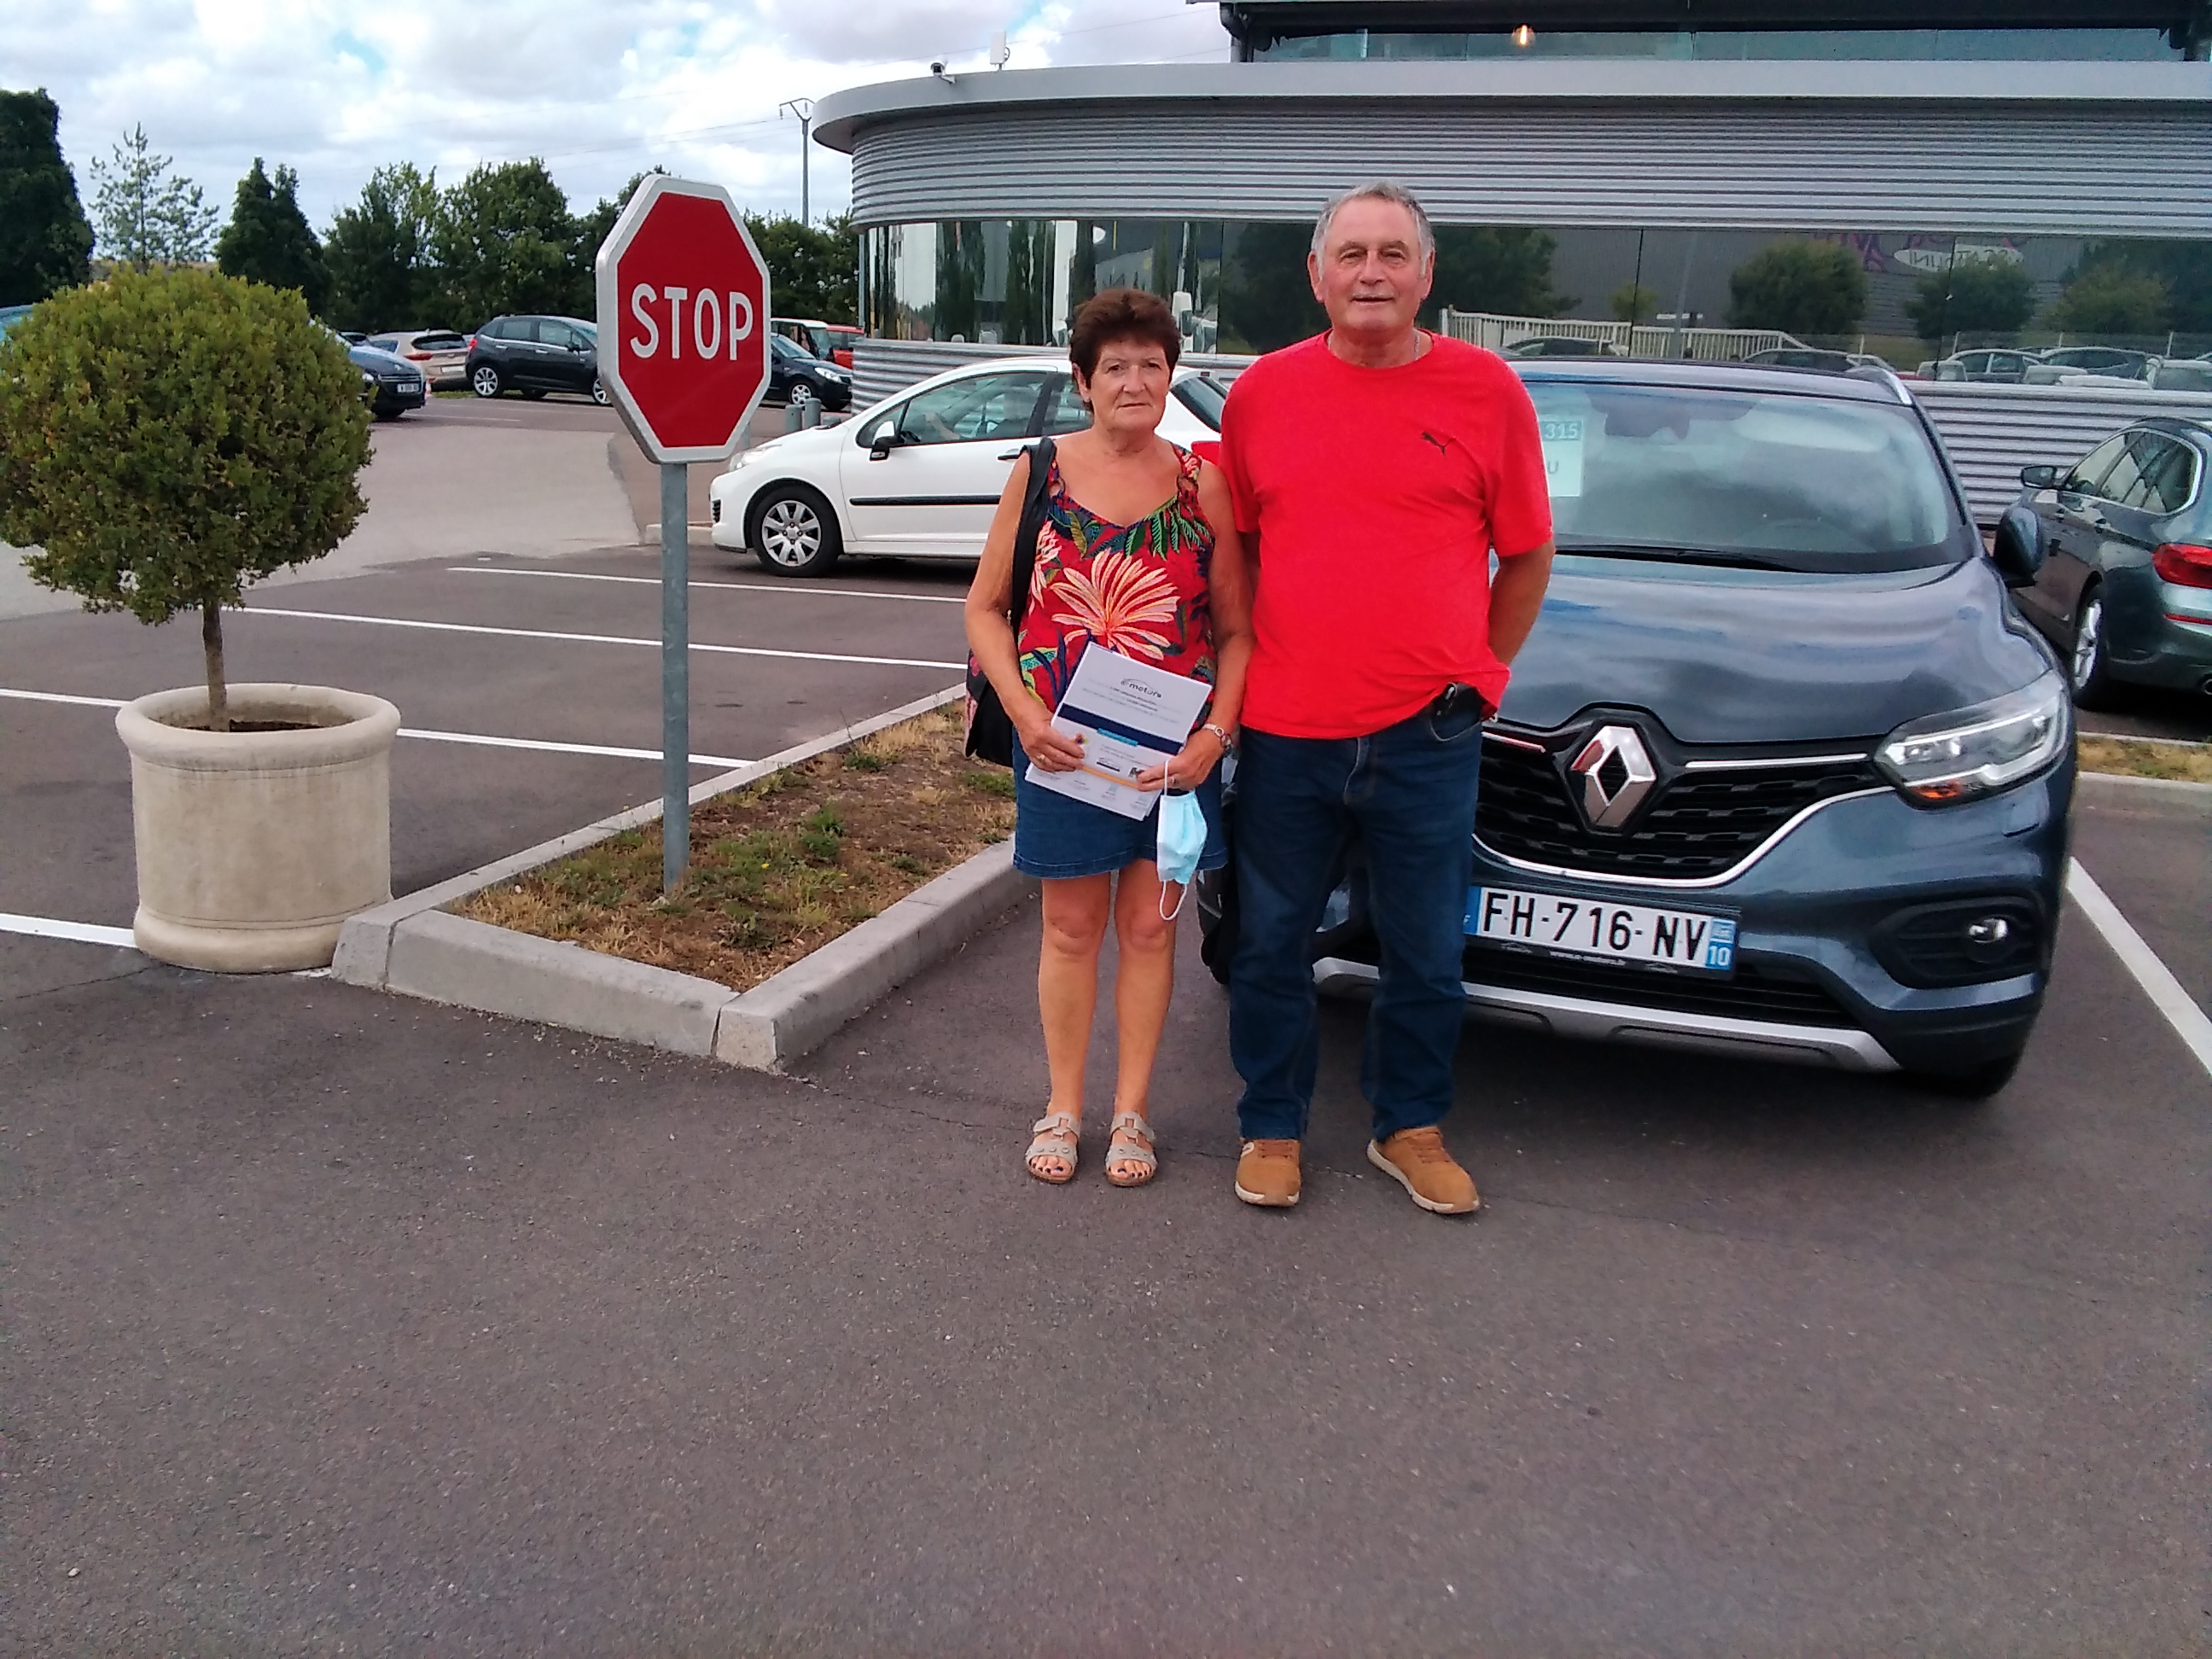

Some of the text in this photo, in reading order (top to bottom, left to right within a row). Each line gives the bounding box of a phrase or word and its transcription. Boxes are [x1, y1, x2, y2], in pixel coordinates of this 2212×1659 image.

[630, 282, 754, 361] STOP
[1482, 891, 1708, 961] FH-716-NV
[1708, 945, 1732, 966] 10
